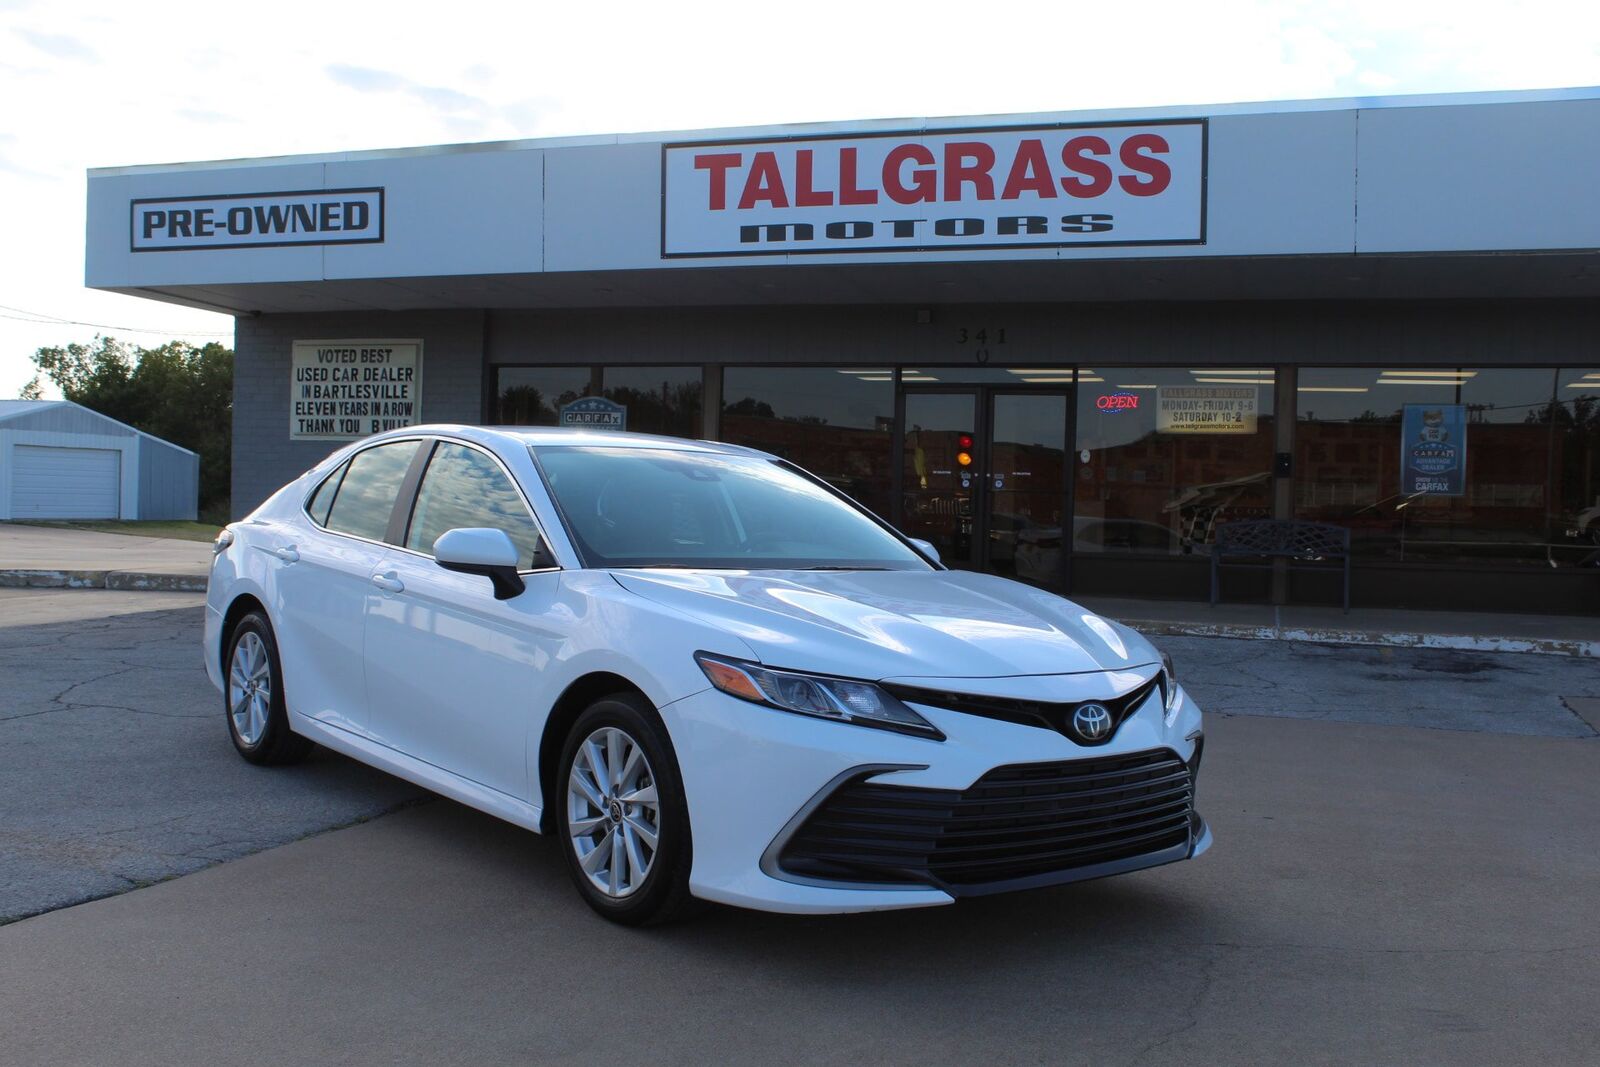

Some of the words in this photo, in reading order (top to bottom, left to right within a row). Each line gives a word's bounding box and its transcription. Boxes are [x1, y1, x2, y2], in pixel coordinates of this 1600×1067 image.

[694, 133, 1171, 210] TALLGRASS
[143, 201, 369, 239] PRE-OWNED
[740, 214, 1114, 243] MOTORS
[317, 349, 357, 363] VOTED
[361, 349, 392, 363] BEST
[297, 368, 328, 381] USED
[332, 368, 359, 381] CAR
[363, 368, 413, 381] DEALER
[302, 385, 311, 398] IN
[313, 385, 408, 399] BARTLESVILLE
[296, 402, 336, 416] ELEVEN
[339, 402, 369, 416] YEARS
[371, 402, 381, 416] IN
[383, 402, 390, 416] A
[391, 402, 413, 416] ROW
[1096, 395, 1140, 410] OPEN
[1162, 400, 1234, 411] MONDAY-FRIDAY
[1238, 400, 1254, 411] 9-6
[566, 413, 620, 424] CARFAX
[1173, 411, 1218, 422] SATURDAY
[1221, 412, 1242, 423] 10-2
[298, 419, 335, 433] THANK
[339, 419, 360, 433] YOU
[1415, 482, 1449, 491] CARFAX
